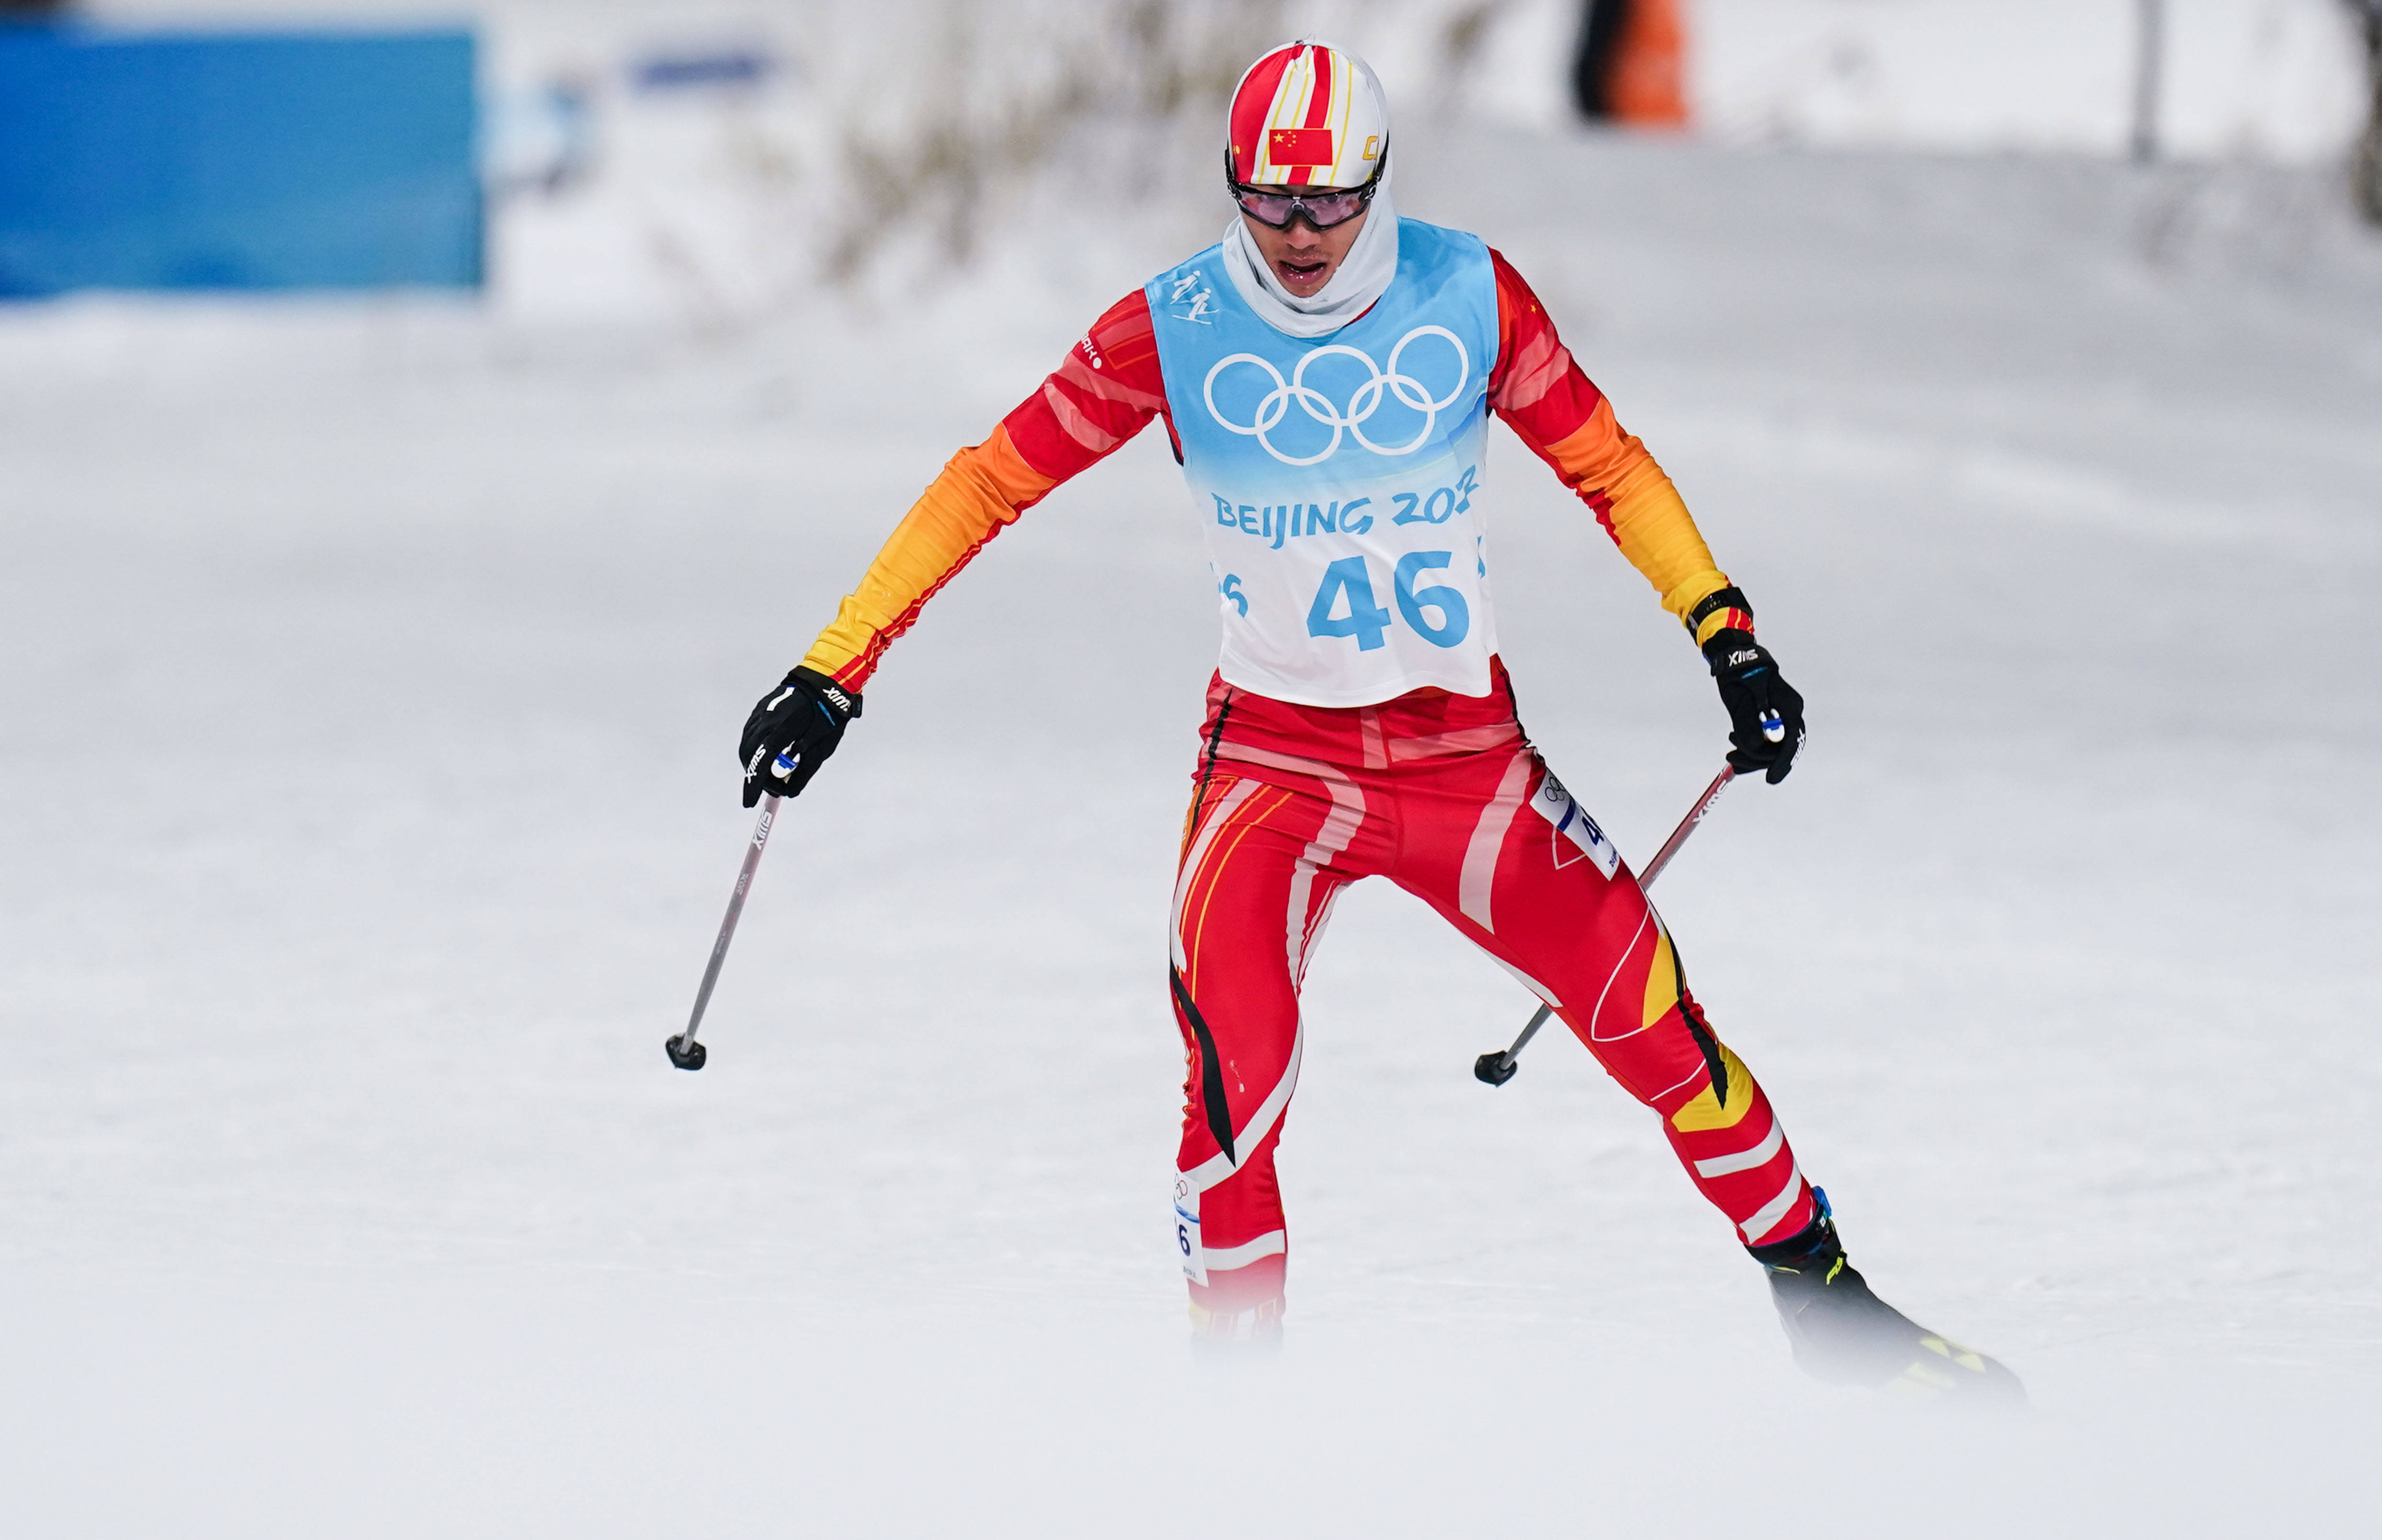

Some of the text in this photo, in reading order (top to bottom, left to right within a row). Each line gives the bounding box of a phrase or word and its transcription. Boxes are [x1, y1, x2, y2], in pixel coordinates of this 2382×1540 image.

[1211, 492, 1373, 550] BEIJING
[1215, 569, 1248, 618] 6
[1306, 551, 1470, 652] 46
[1581, 808, 1605, 846] 4
[1178, 1223, 1191, 1257] 6
